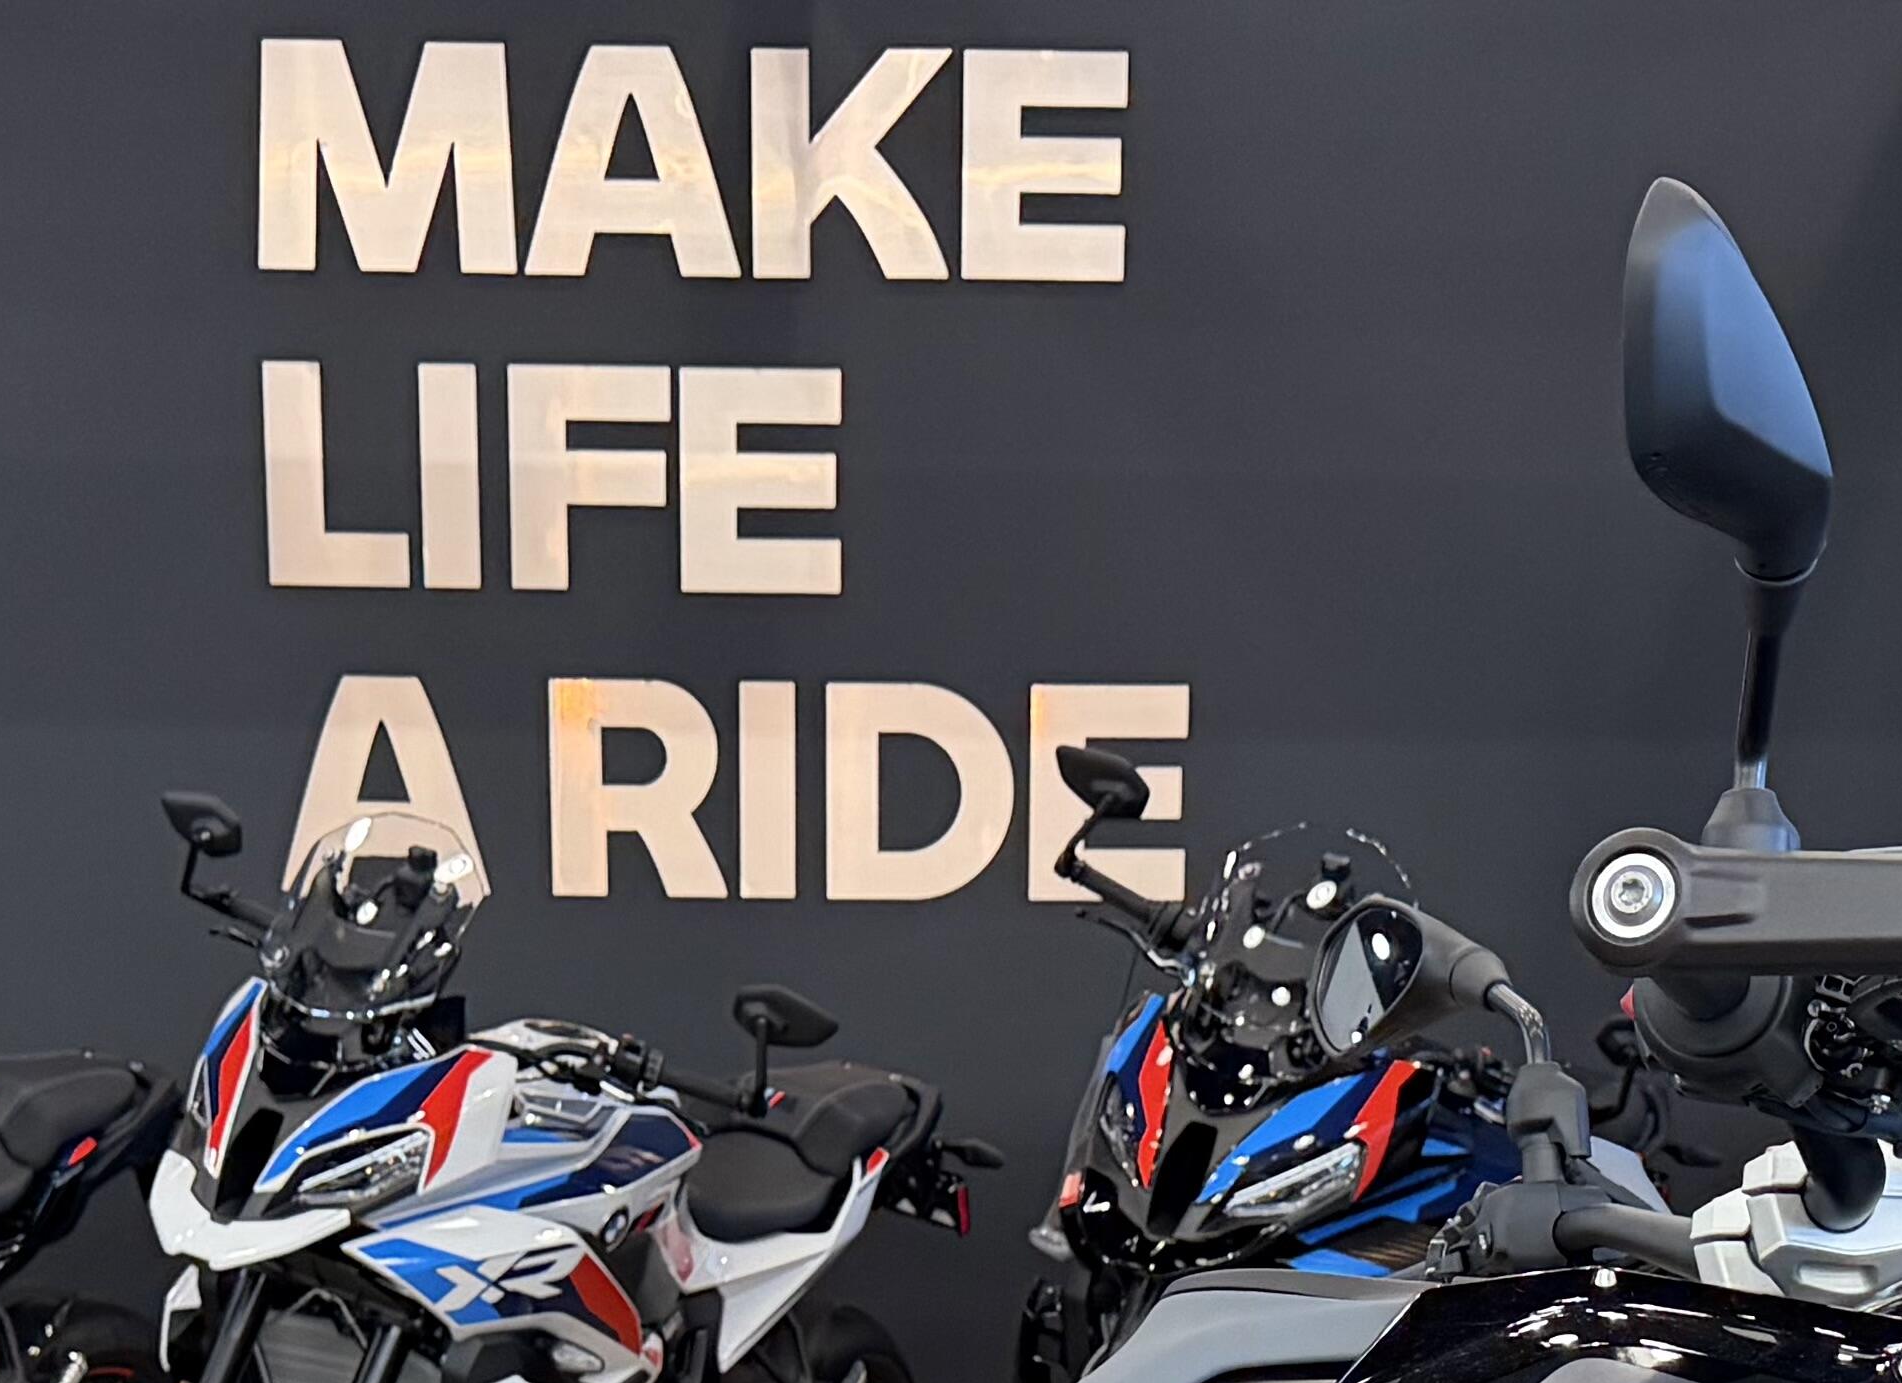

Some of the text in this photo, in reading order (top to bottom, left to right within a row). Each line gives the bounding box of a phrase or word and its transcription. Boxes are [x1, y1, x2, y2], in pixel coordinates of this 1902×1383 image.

[258, 38, 1130, 283] MAKE
[261, 360, 843, 596] LIFE
[280, 674, 1191, 902] A RIDE
